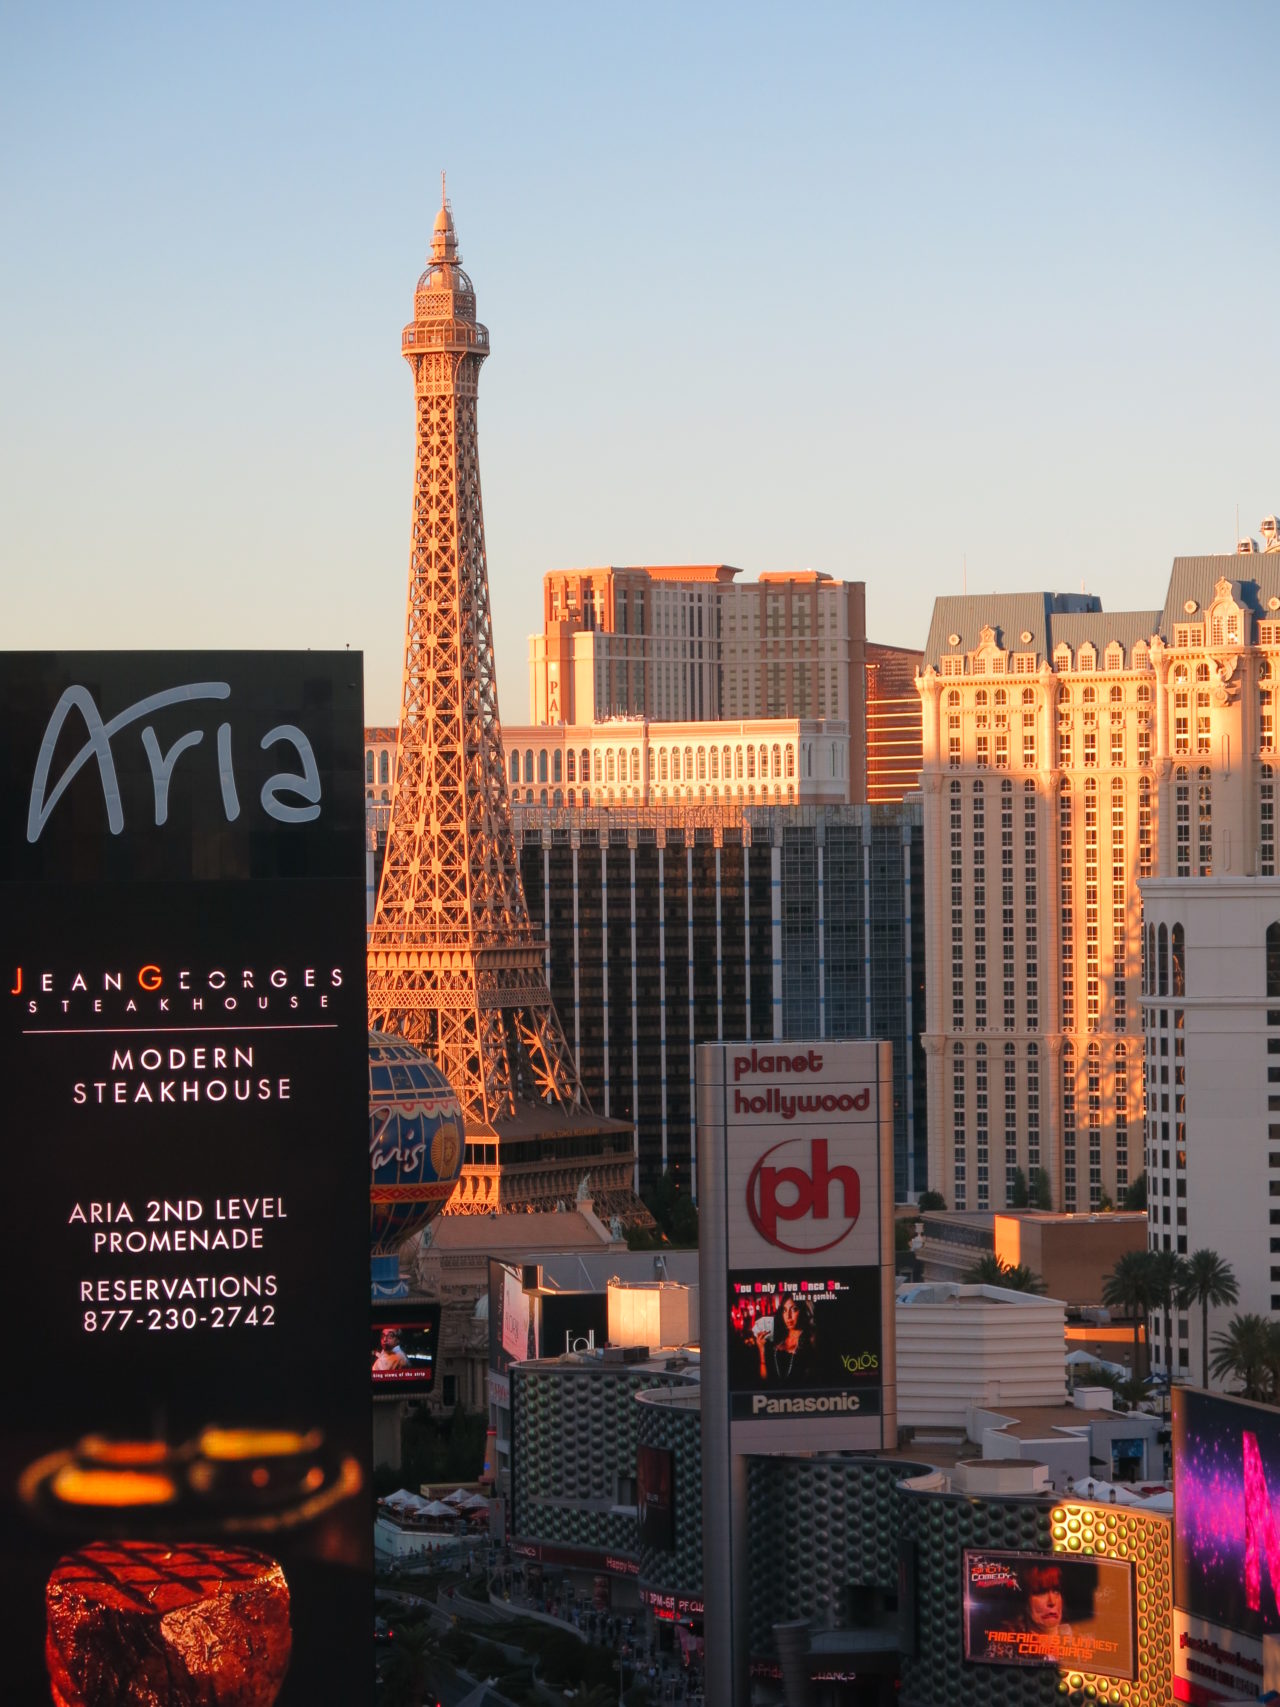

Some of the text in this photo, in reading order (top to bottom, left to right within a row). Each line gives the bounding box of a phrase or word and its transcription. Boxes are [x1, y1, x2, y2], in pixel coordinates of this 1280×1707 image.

[26, 682, 322, 843] Aria
[28, 995, 329, 1013] STEAKHOUSE
[111, 1047, 255, 1070] MODERN
[734, 1048, 823, 1081] planet
[73, 1078, 291, 1104] STEAKHOUSE
[734, 1087, 870, 1119] hollywood
[759, 1138, 861, 1240] ph
[68, 1197, 287, 1224] ARIA 2ND LEVEL
[93, 1227, 264, 1253] PROMENADE
[80, 1275, 278, 1302] RESERVATIONS
[734, 1280, 850, 1294] You Only Live Once So...
[792, 1292, 806, 1301] Take
[83, 1305, 276, 1332] 877-230-2742
[752, 1392, 860, 1414] Panasonic
[971, 1572, 1013, 1583] COMEDY
